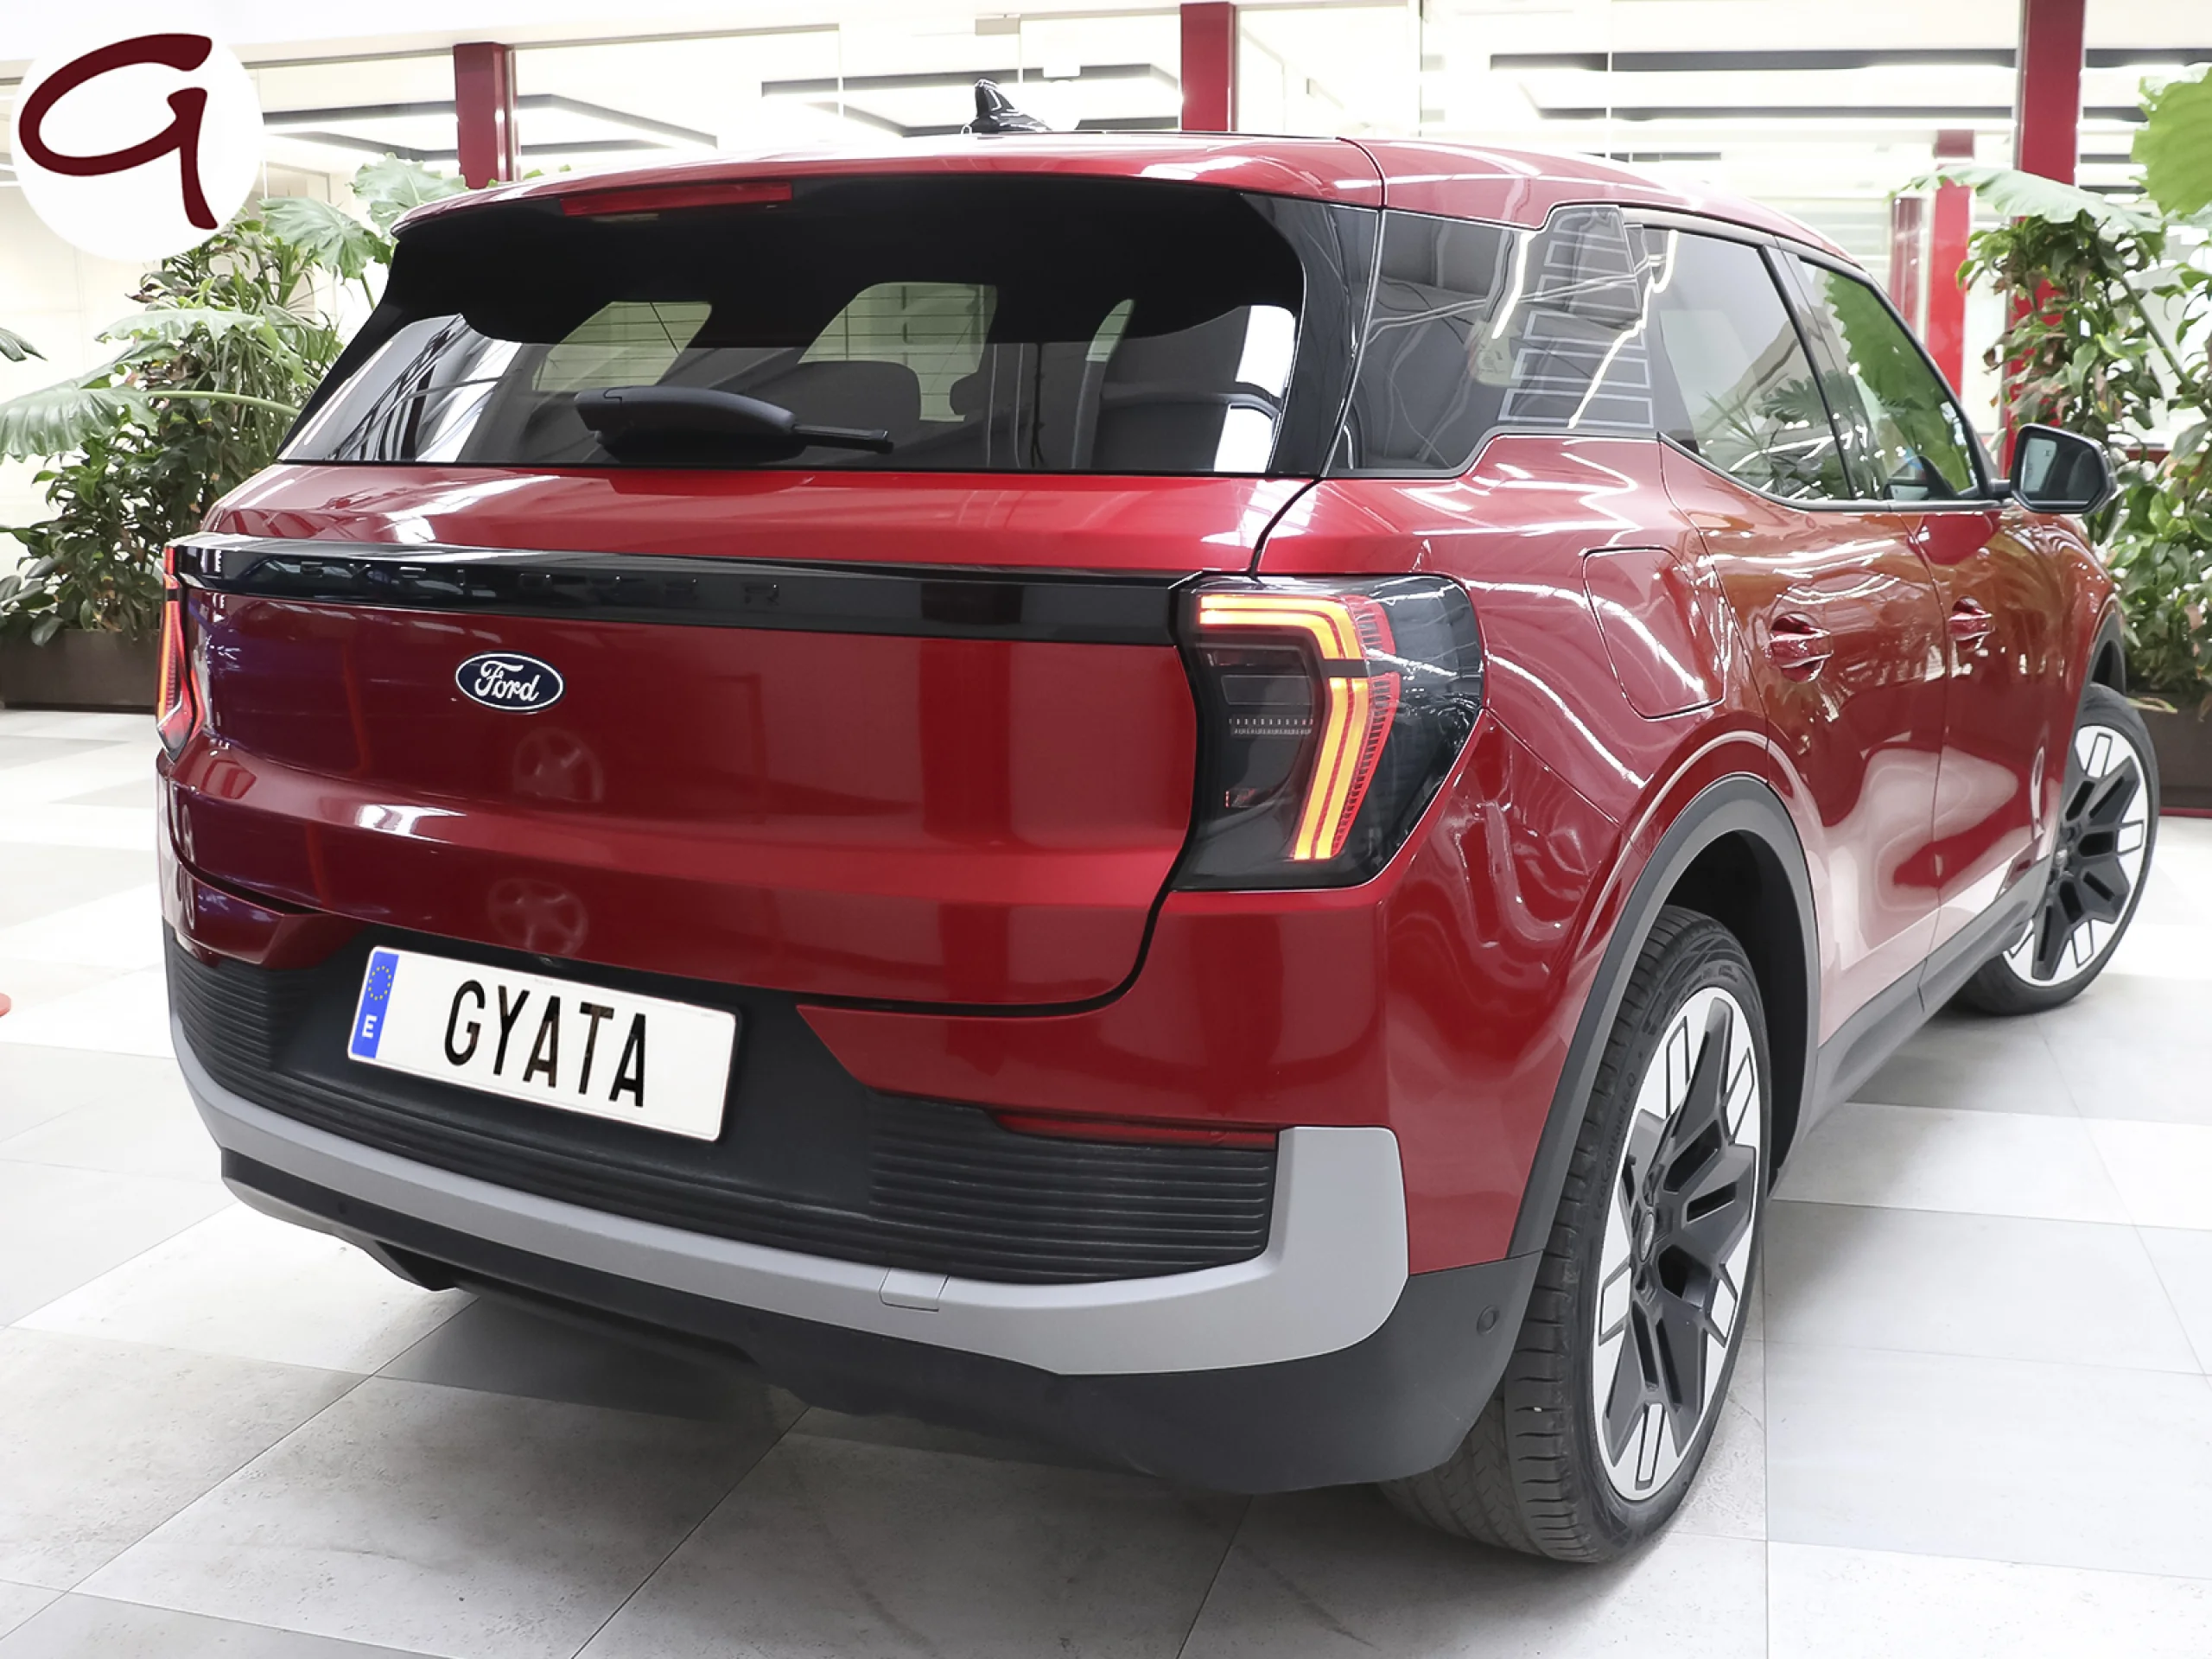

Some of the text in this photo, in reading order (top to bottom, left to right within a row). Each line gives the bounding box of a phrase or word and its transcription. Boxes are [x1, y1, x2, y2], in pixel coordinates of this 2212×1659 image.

[474, 660, 541, 702] Ford
[362, 979, 647, 1109] E GYATA
